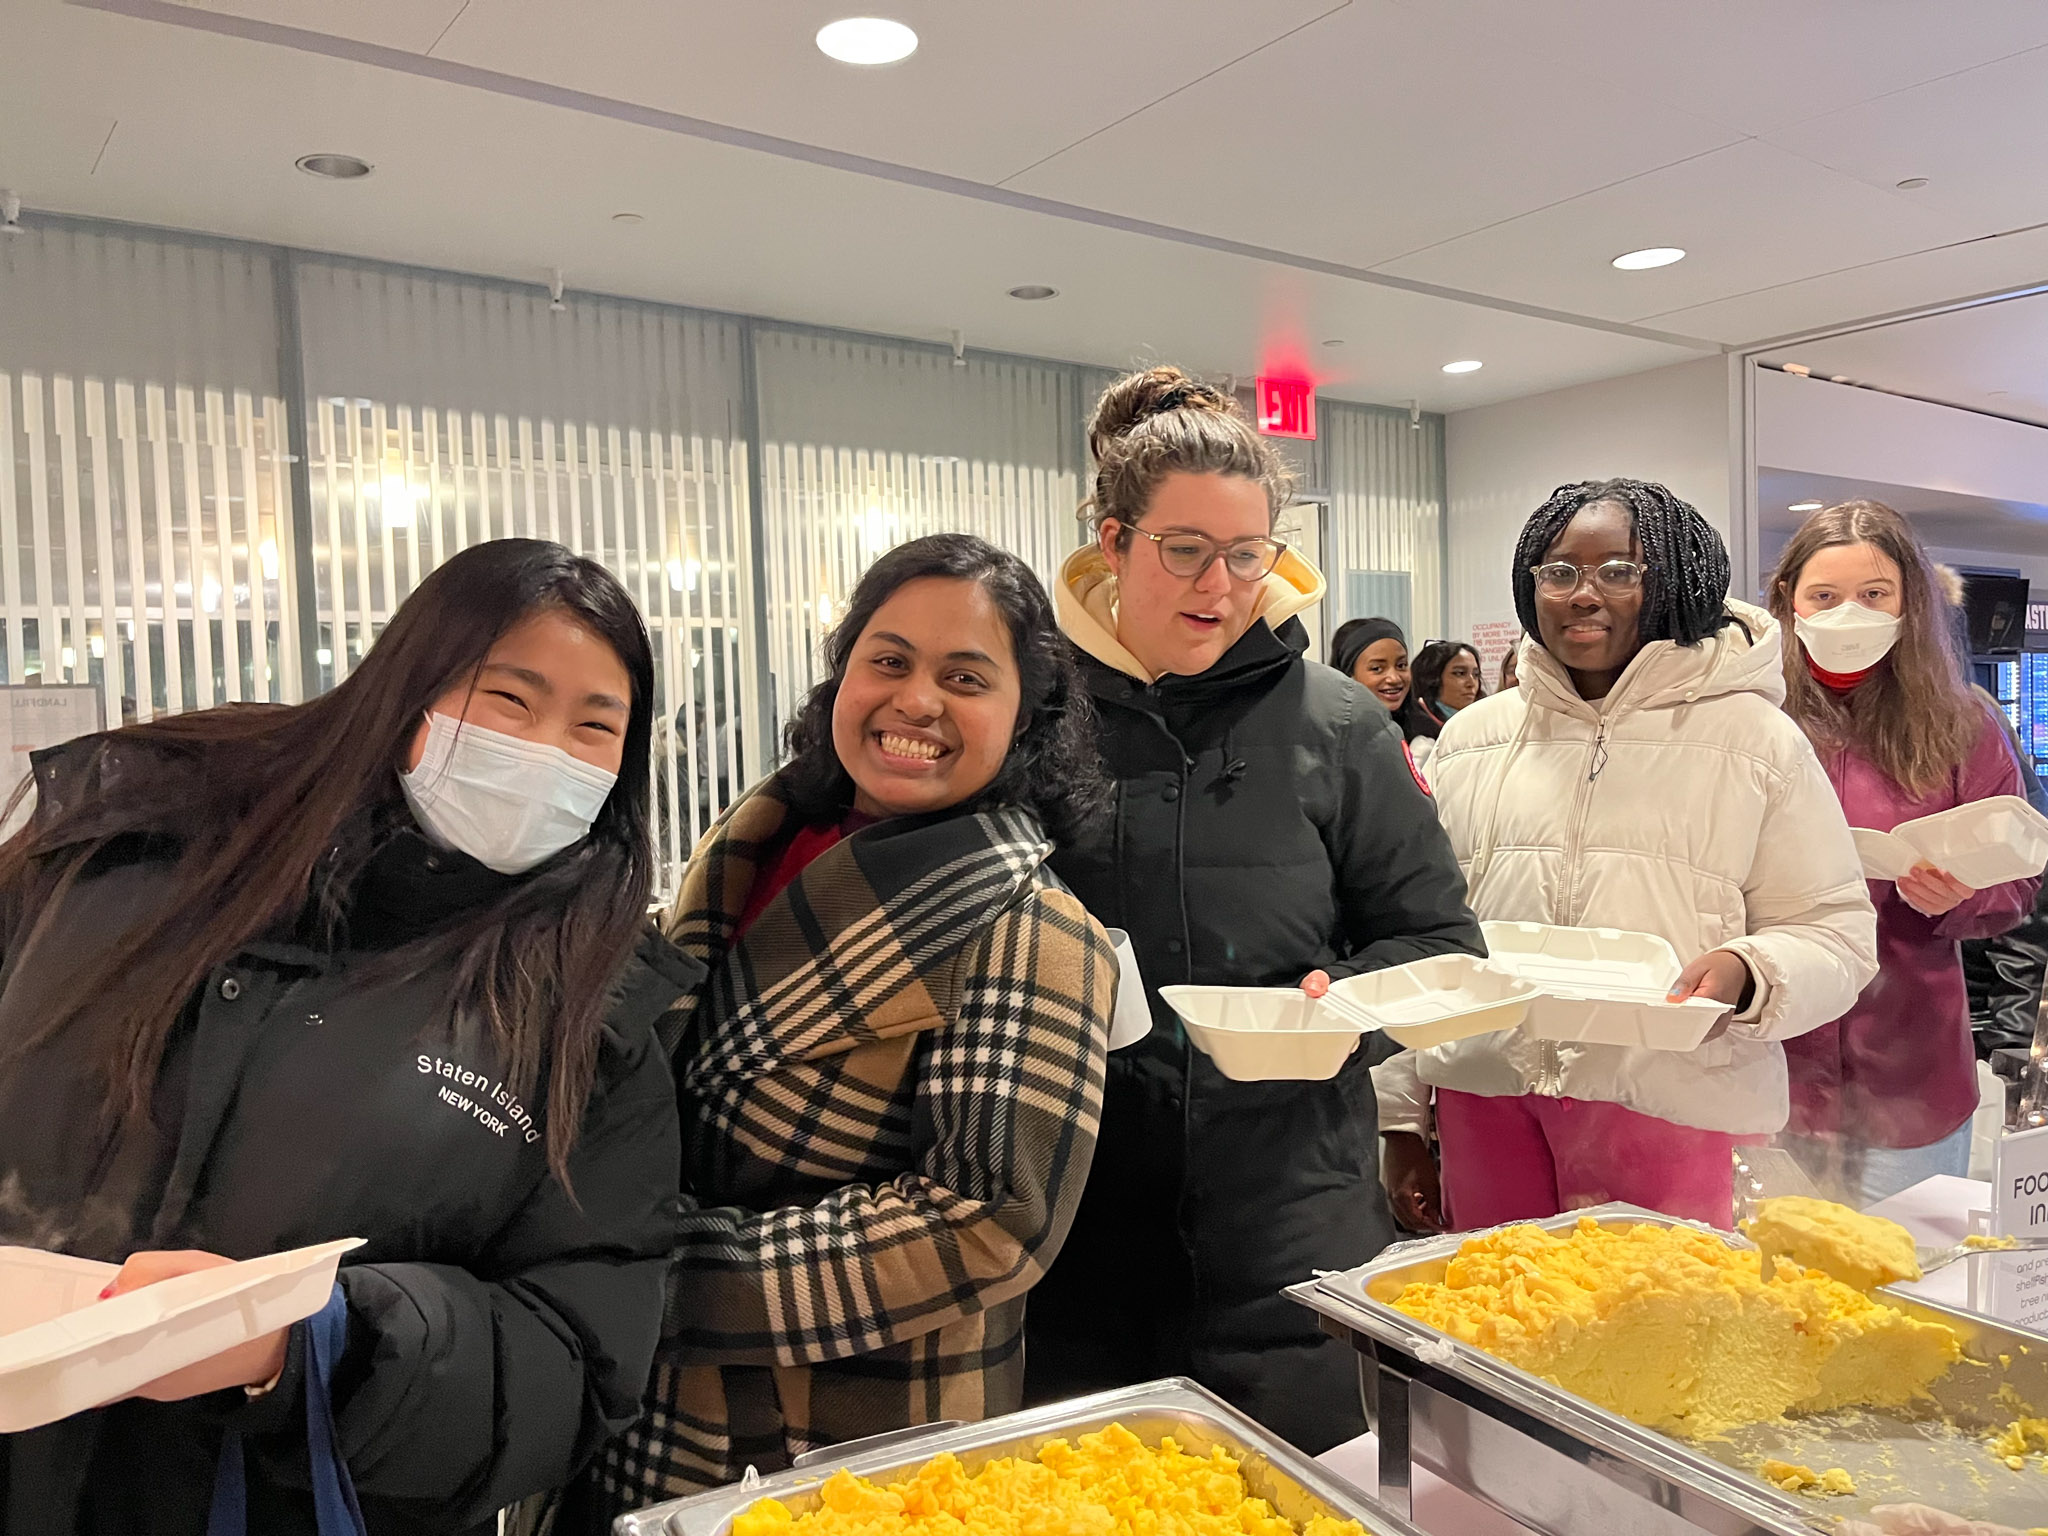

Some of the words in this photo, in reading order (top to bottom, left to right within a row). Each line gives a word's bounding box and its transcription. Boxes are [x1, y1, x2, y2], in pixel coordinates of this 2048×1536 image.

[1264, 381, 1310, 433] EXIT
[1472, 622, 1511, 630] OCCUPANCY
[2025, 604, 2048, 629] AST
[417, 1054, 489, 1092] Staten
[490, 1082, 542, 1144] Island
[438, 1085, 474, 1112] NEW
[472, 1103, 510, 1138] YORK
[2016, 1259, 2034, 1274] and
[2020, 1296, 2039, 1309] tree
